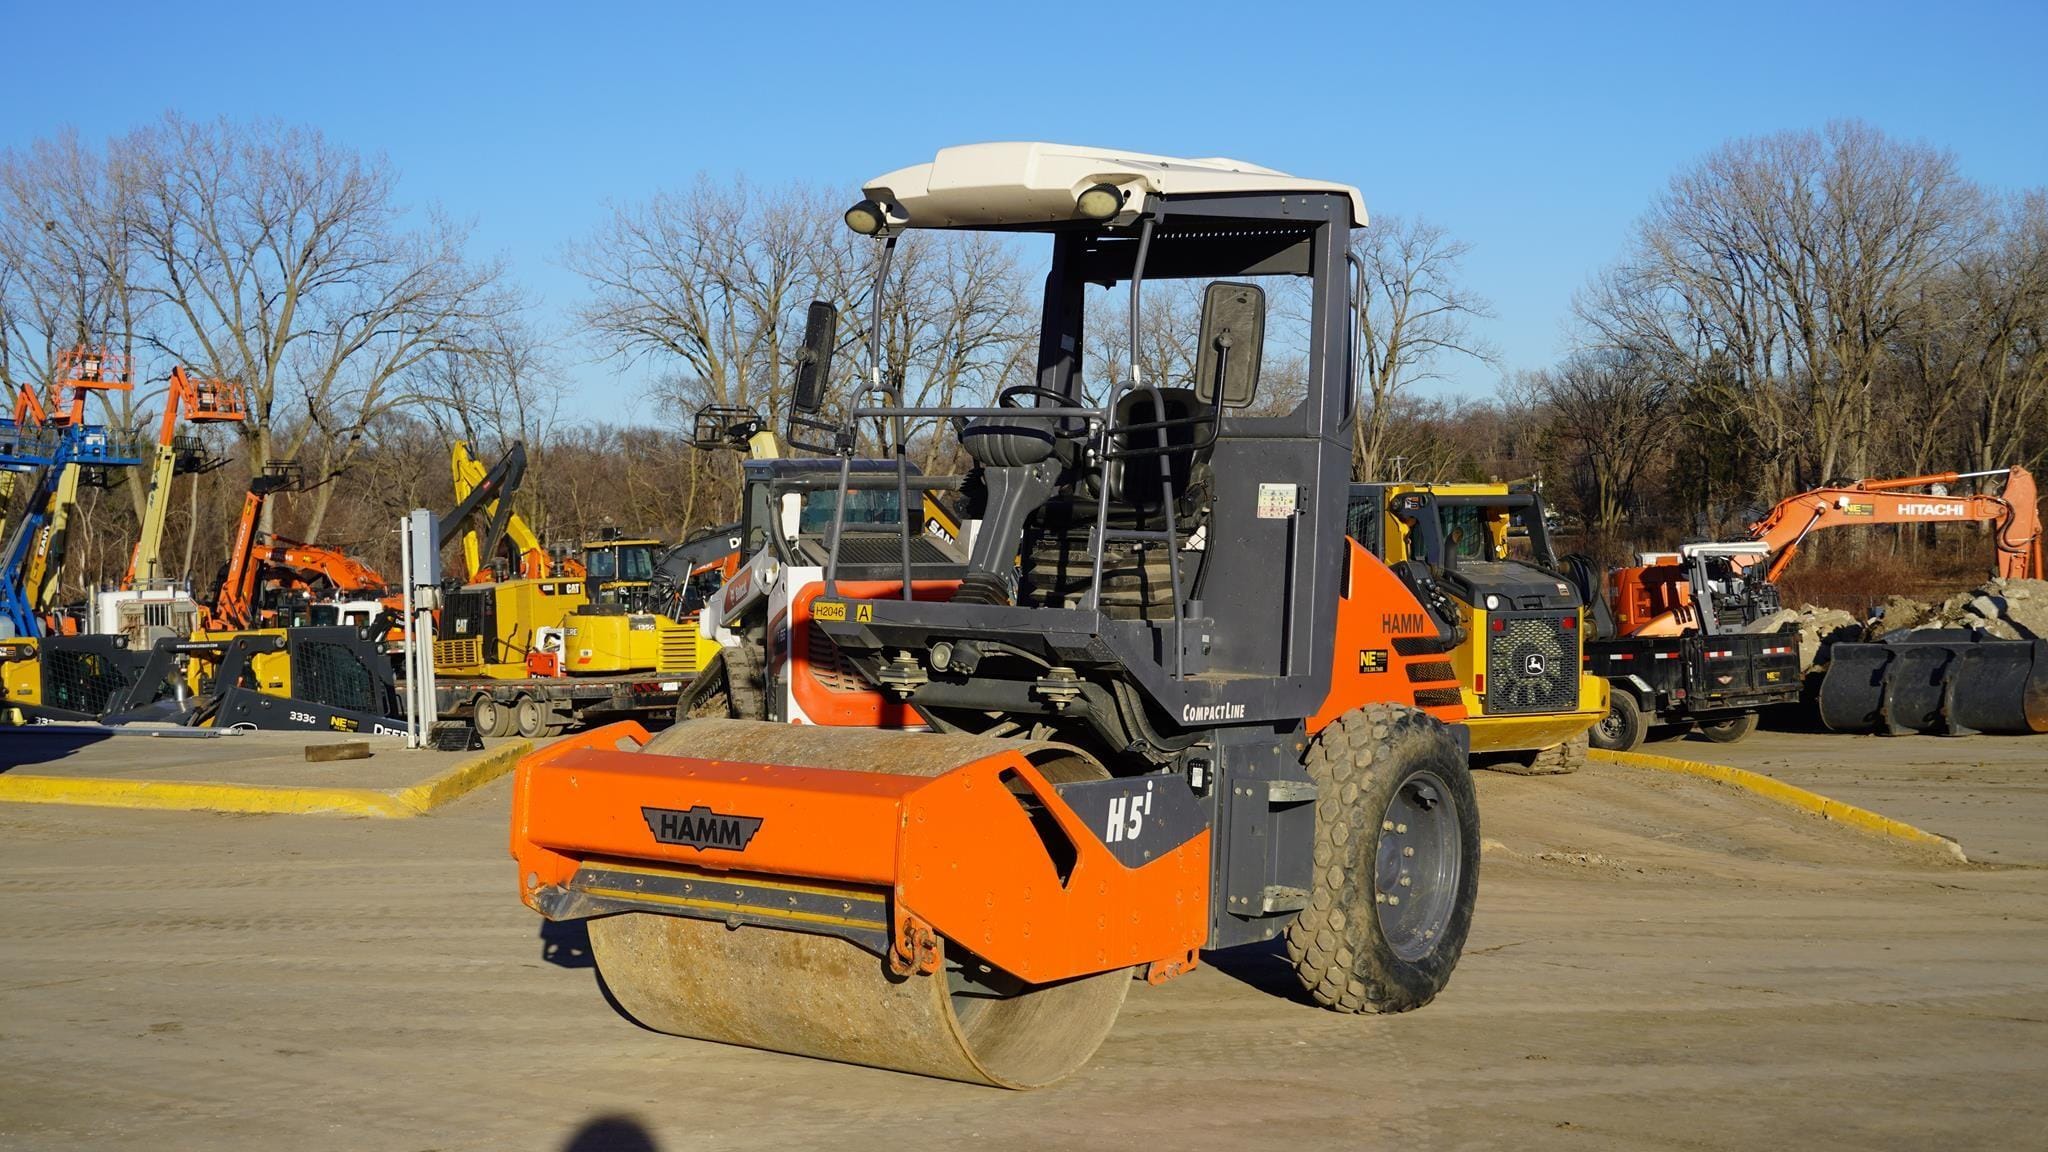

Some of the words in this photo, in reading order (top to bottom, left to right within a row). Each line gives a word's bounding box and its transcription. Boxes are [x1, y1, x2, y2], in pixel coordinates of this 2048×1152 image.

[1897, 504, 1964, 516] HITACHI
[729, 537, 742, 549] D
[566, 583, 580, 594] CAT
[816, 605, 844, 617] H2046
[858, 605, 869, 621] A
[456, 618, 468, 633] CAT
[1382, 613, 1424, 634] HAMM
[1360, 651, 1377, 666] NE
[289, 711, 317, 724] 333G
[330, 715, 347, 728] NE
[661, 814, 741, 846] HAMM
